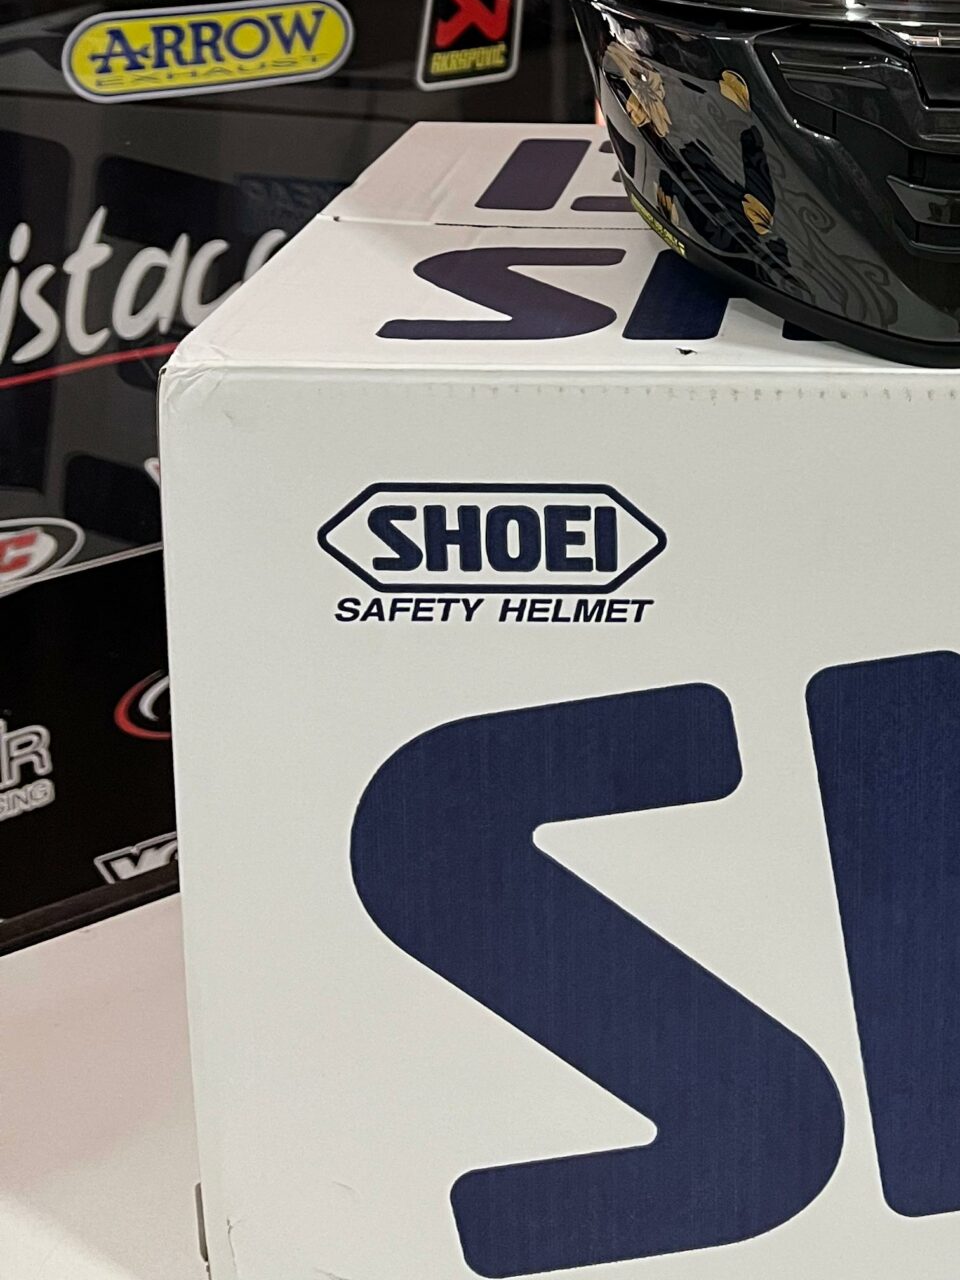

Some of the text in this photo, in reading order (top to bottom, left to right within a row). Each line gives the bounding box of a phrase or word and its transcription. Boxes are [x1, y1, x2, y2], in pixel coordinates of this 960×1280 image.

[90, 10, 326, 74] ARROW
[96, 51, 333, 87] EXHAUST
[367, 504, 618, 572] SHOEI
[334, 597, 655, 624] SAFETY HELMET
